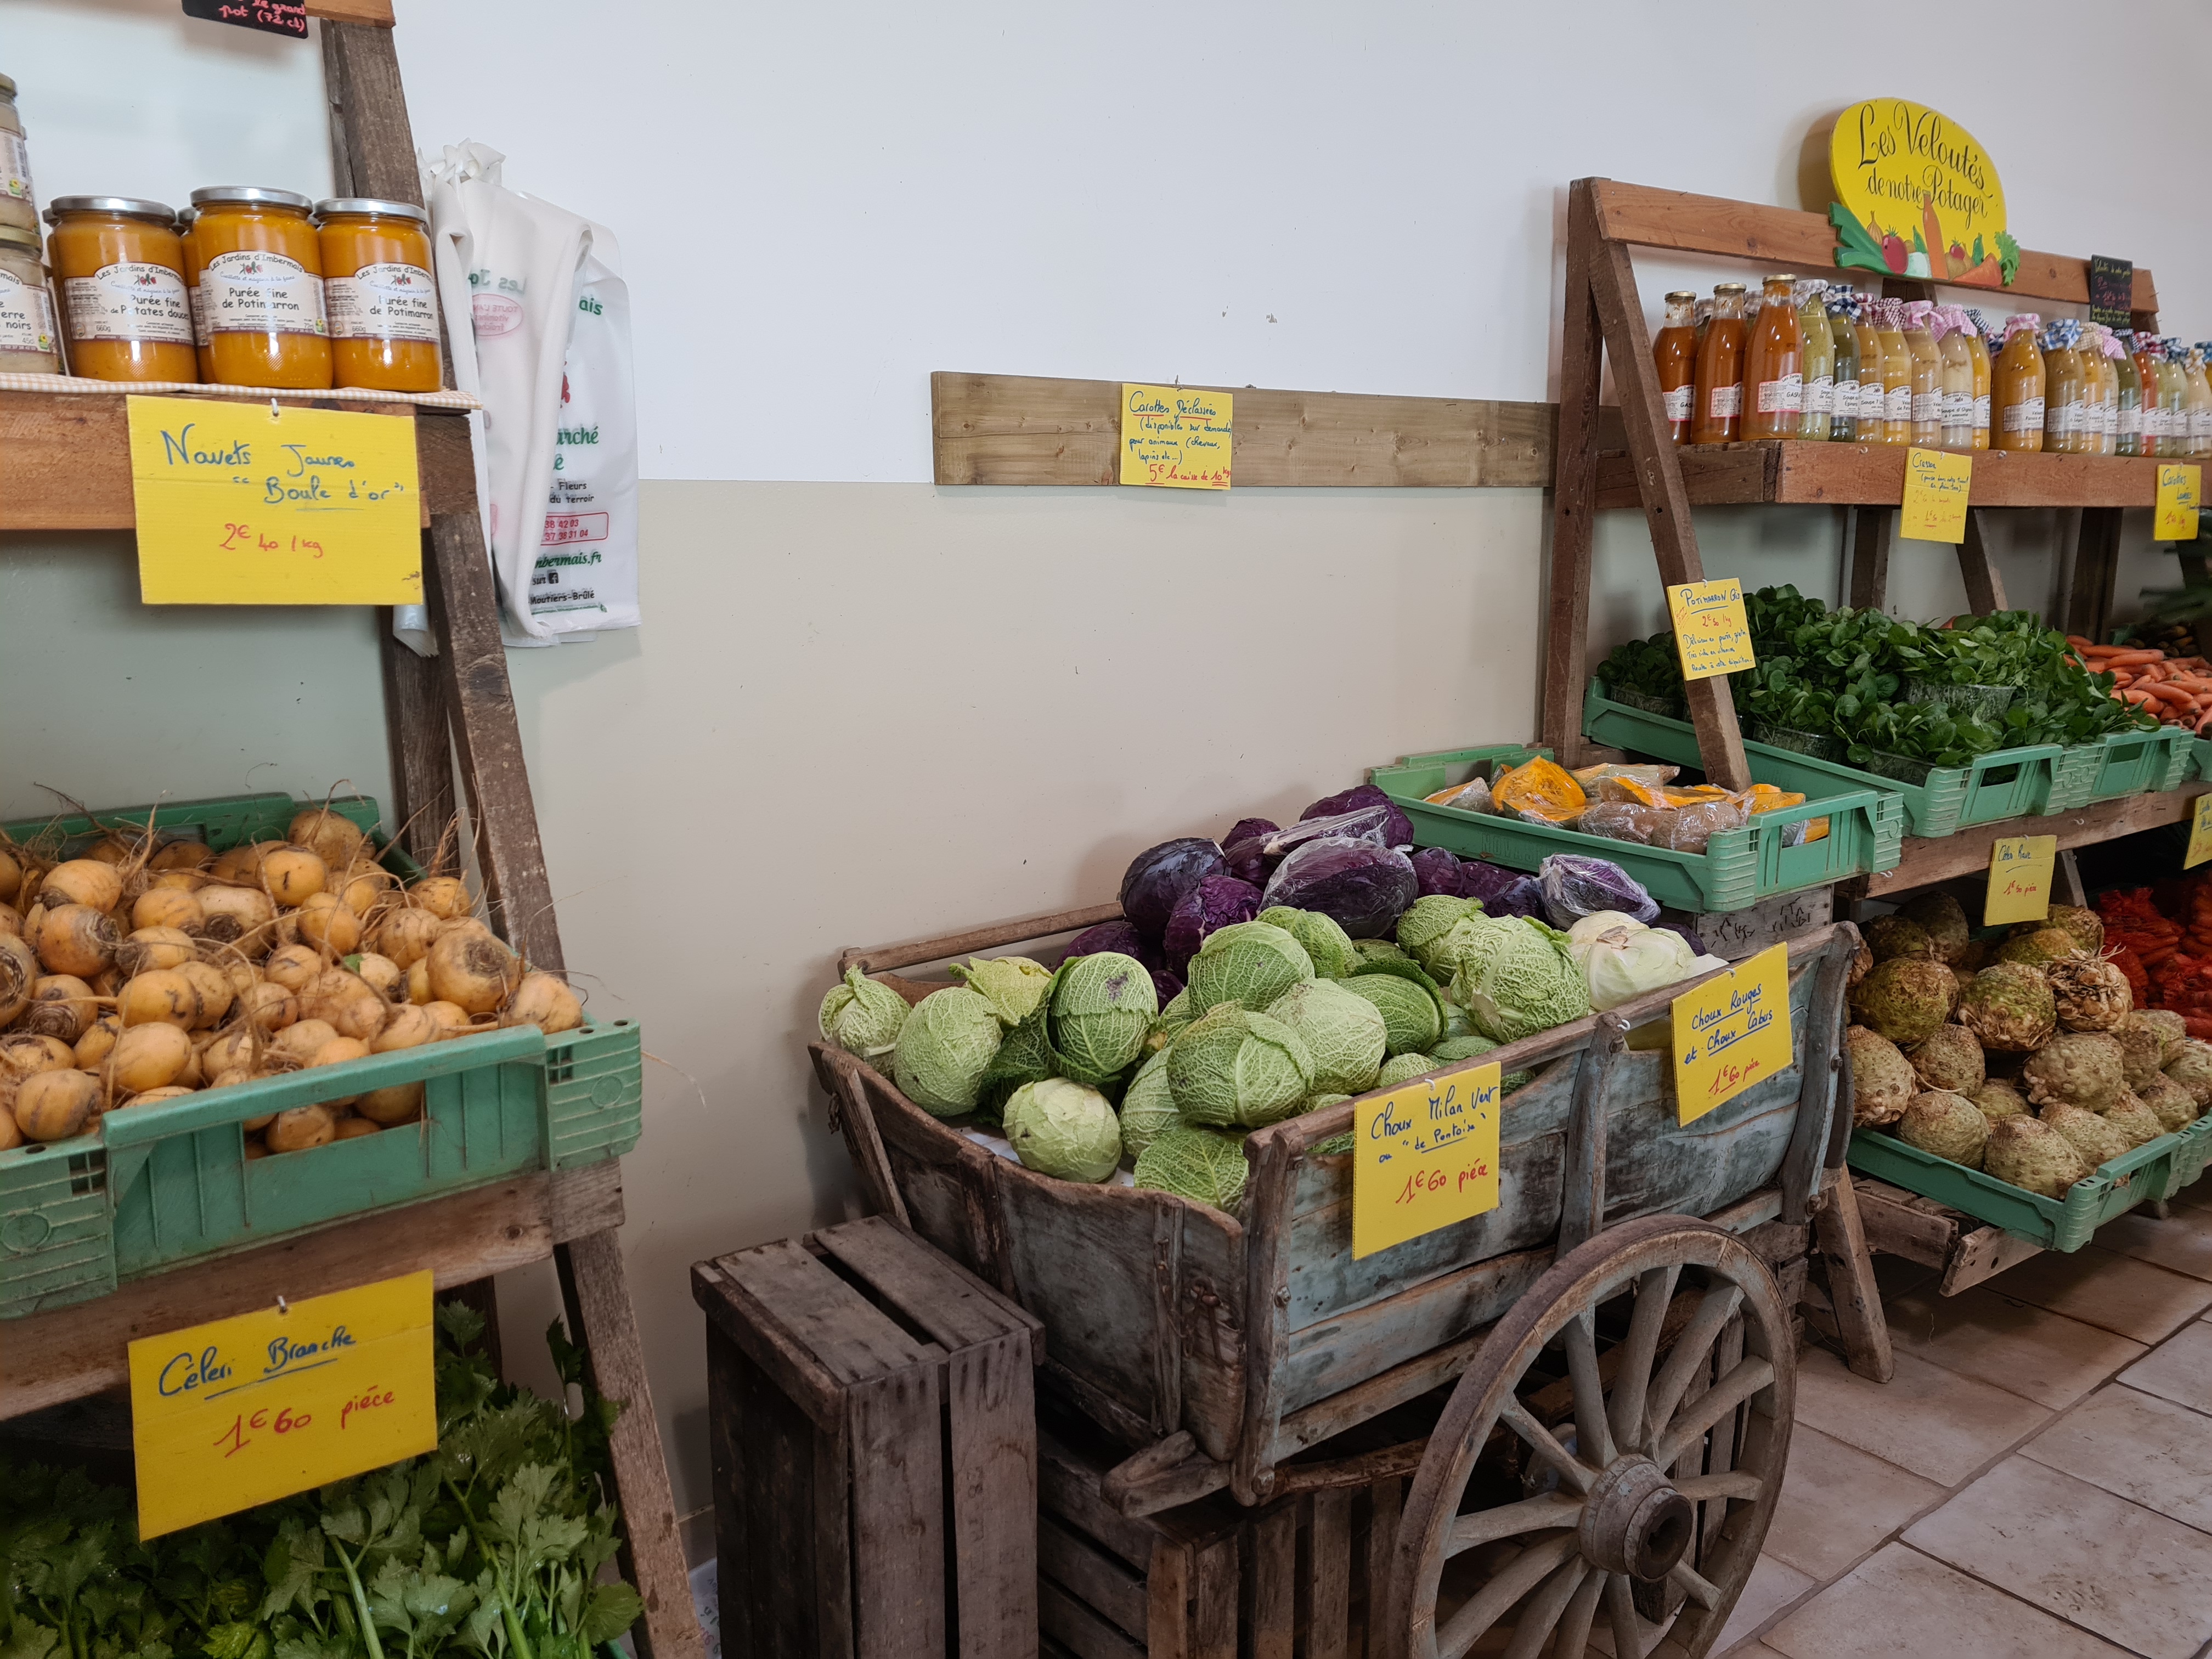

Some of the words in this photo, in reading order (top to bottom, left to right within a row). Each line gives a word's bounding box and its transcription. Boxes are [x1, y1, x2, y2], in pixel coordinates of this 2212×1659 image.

[1858, 103, 1896, 171] Les
[1893, 100, 1994, 199] Veloutés
[1865, 167, 1884, 197] de
[1886, 174, 1924, 210] notre
[1922, 165, 1988, 231] Potager
[229, 286, 261, 297] Purée
[222, 299, 234, 309] de
[1129, 391, 1170, 413] Carottes
[160, 423, 252, 466] Navets
[281, 444, 355, 477] Jaunes
[1129, 438, 1145, 453] pour
[1149, 436, 1178, 447] animaux
[558, 482, 587, 491] Fleurs
[550, 495, 561, 504] du
[566, 494, 595, 504] terroir
[558, 520, 568, 529] 42
[569, 518, 579, 527] 03
[545, 532, 555, 541] 37
[568, 531, 577, 539] 31
[579, 529, 589, 538] 04
[1691, 1007, 1722, 1030] Choux
[1730, 983, 1762, 1015] Rouges
[1684, 1045, 1698, 1065] et
[1707, 1029, 1736, 1051] Choux
[1371, 1101, 1412, 1140] Choux
[1428, 1085, 1463, 1121] Milan
[1471, 1086, 1499, 1110] Vert
[1379, 1153, 1393, 1164] ou
[159, 1346, 235, 1397] Céleri
[263, 1325, 357, 1374] Branche
